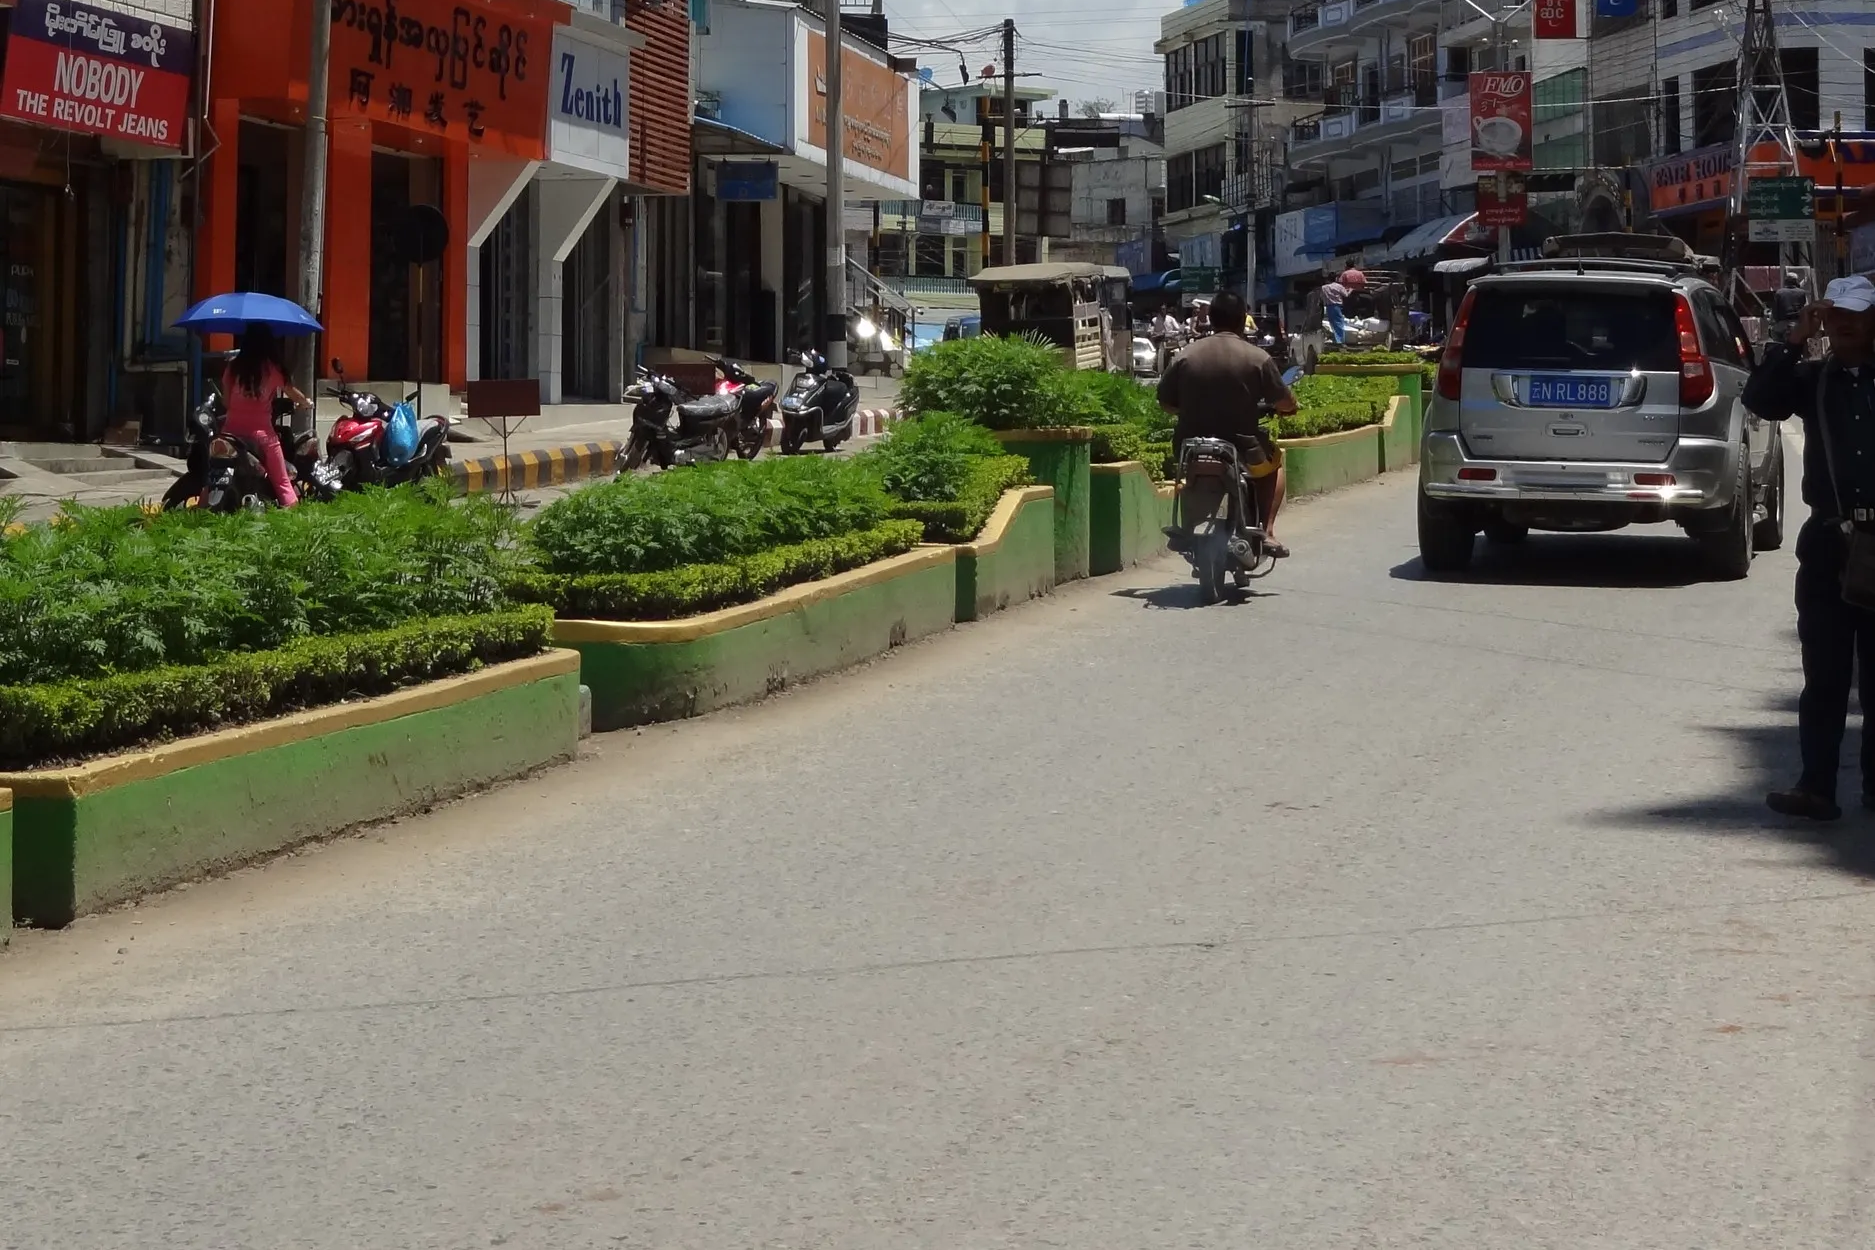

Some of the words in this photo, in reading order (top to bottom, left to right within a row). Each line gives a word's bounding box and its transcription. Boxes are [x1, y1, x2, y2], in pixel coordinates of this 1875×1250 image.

[53, 51, 145, 108] NOBODY
[560, 52, 622, 129] Zenith
[16, 88, 49, 116] THE
[52, 97, 116, 129] REVOLT
[117, 112, 169, 141] JEANS
